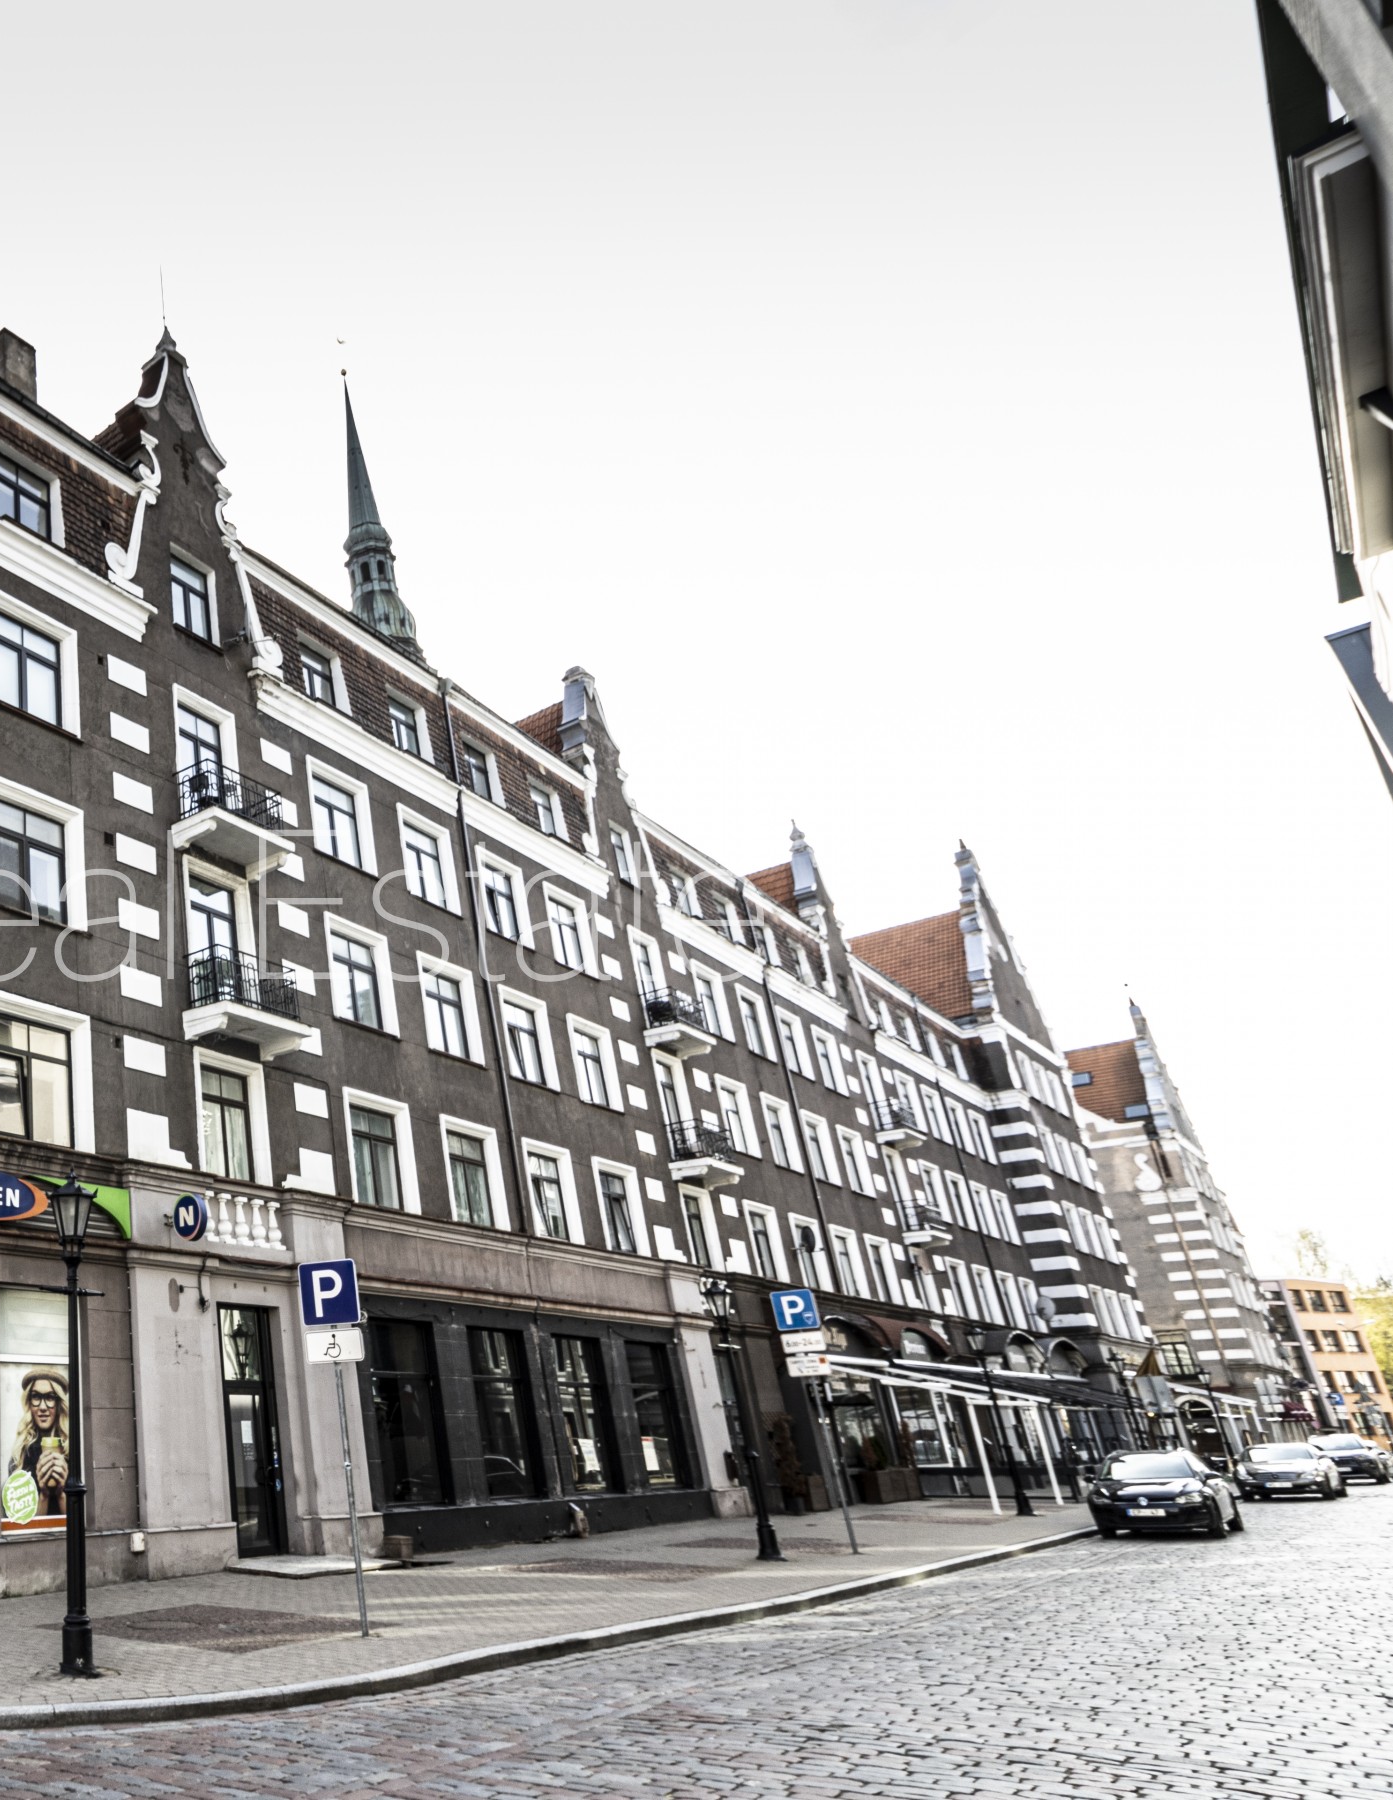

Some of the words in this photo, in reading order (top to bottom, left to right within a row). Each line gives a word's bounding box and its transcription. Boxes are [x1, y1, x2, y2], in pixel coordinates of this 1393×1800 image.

[179, 1206, 194, 1227] N
[312, 1269, 342, 1317] P
[780, 1295, 804, 1325] P
